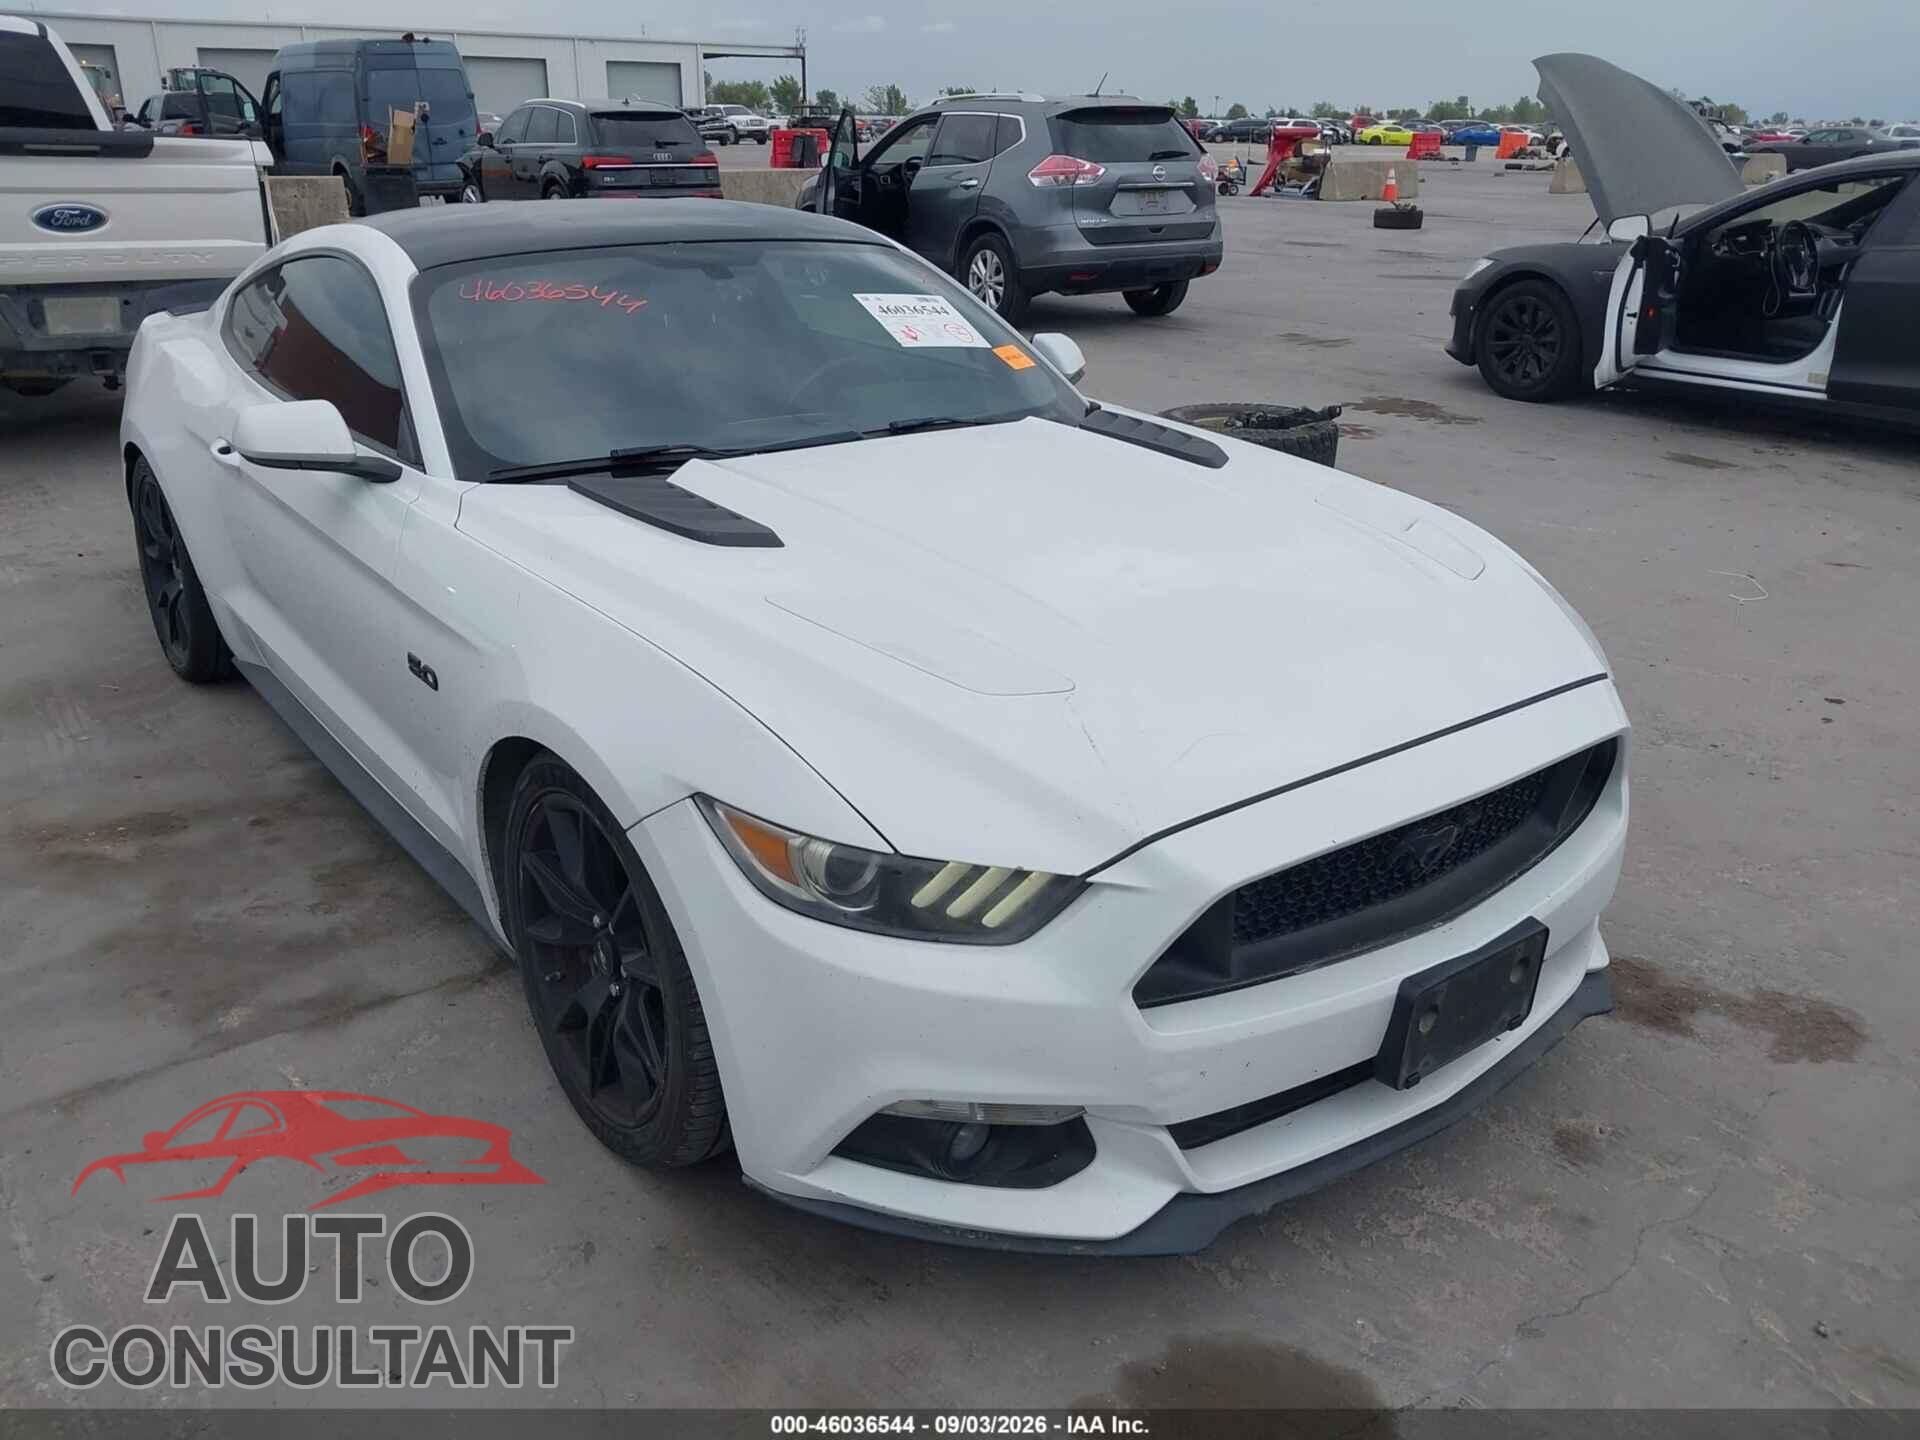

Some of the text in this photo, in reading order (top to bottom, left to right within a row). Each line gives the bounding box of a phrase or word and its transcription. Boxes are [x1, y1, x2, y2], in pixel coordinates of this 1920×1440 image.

[50, 209, 91, 226] Ford
[459, 279, 649, 314] 46036544
[878, 304, 951, 316] 46036544
